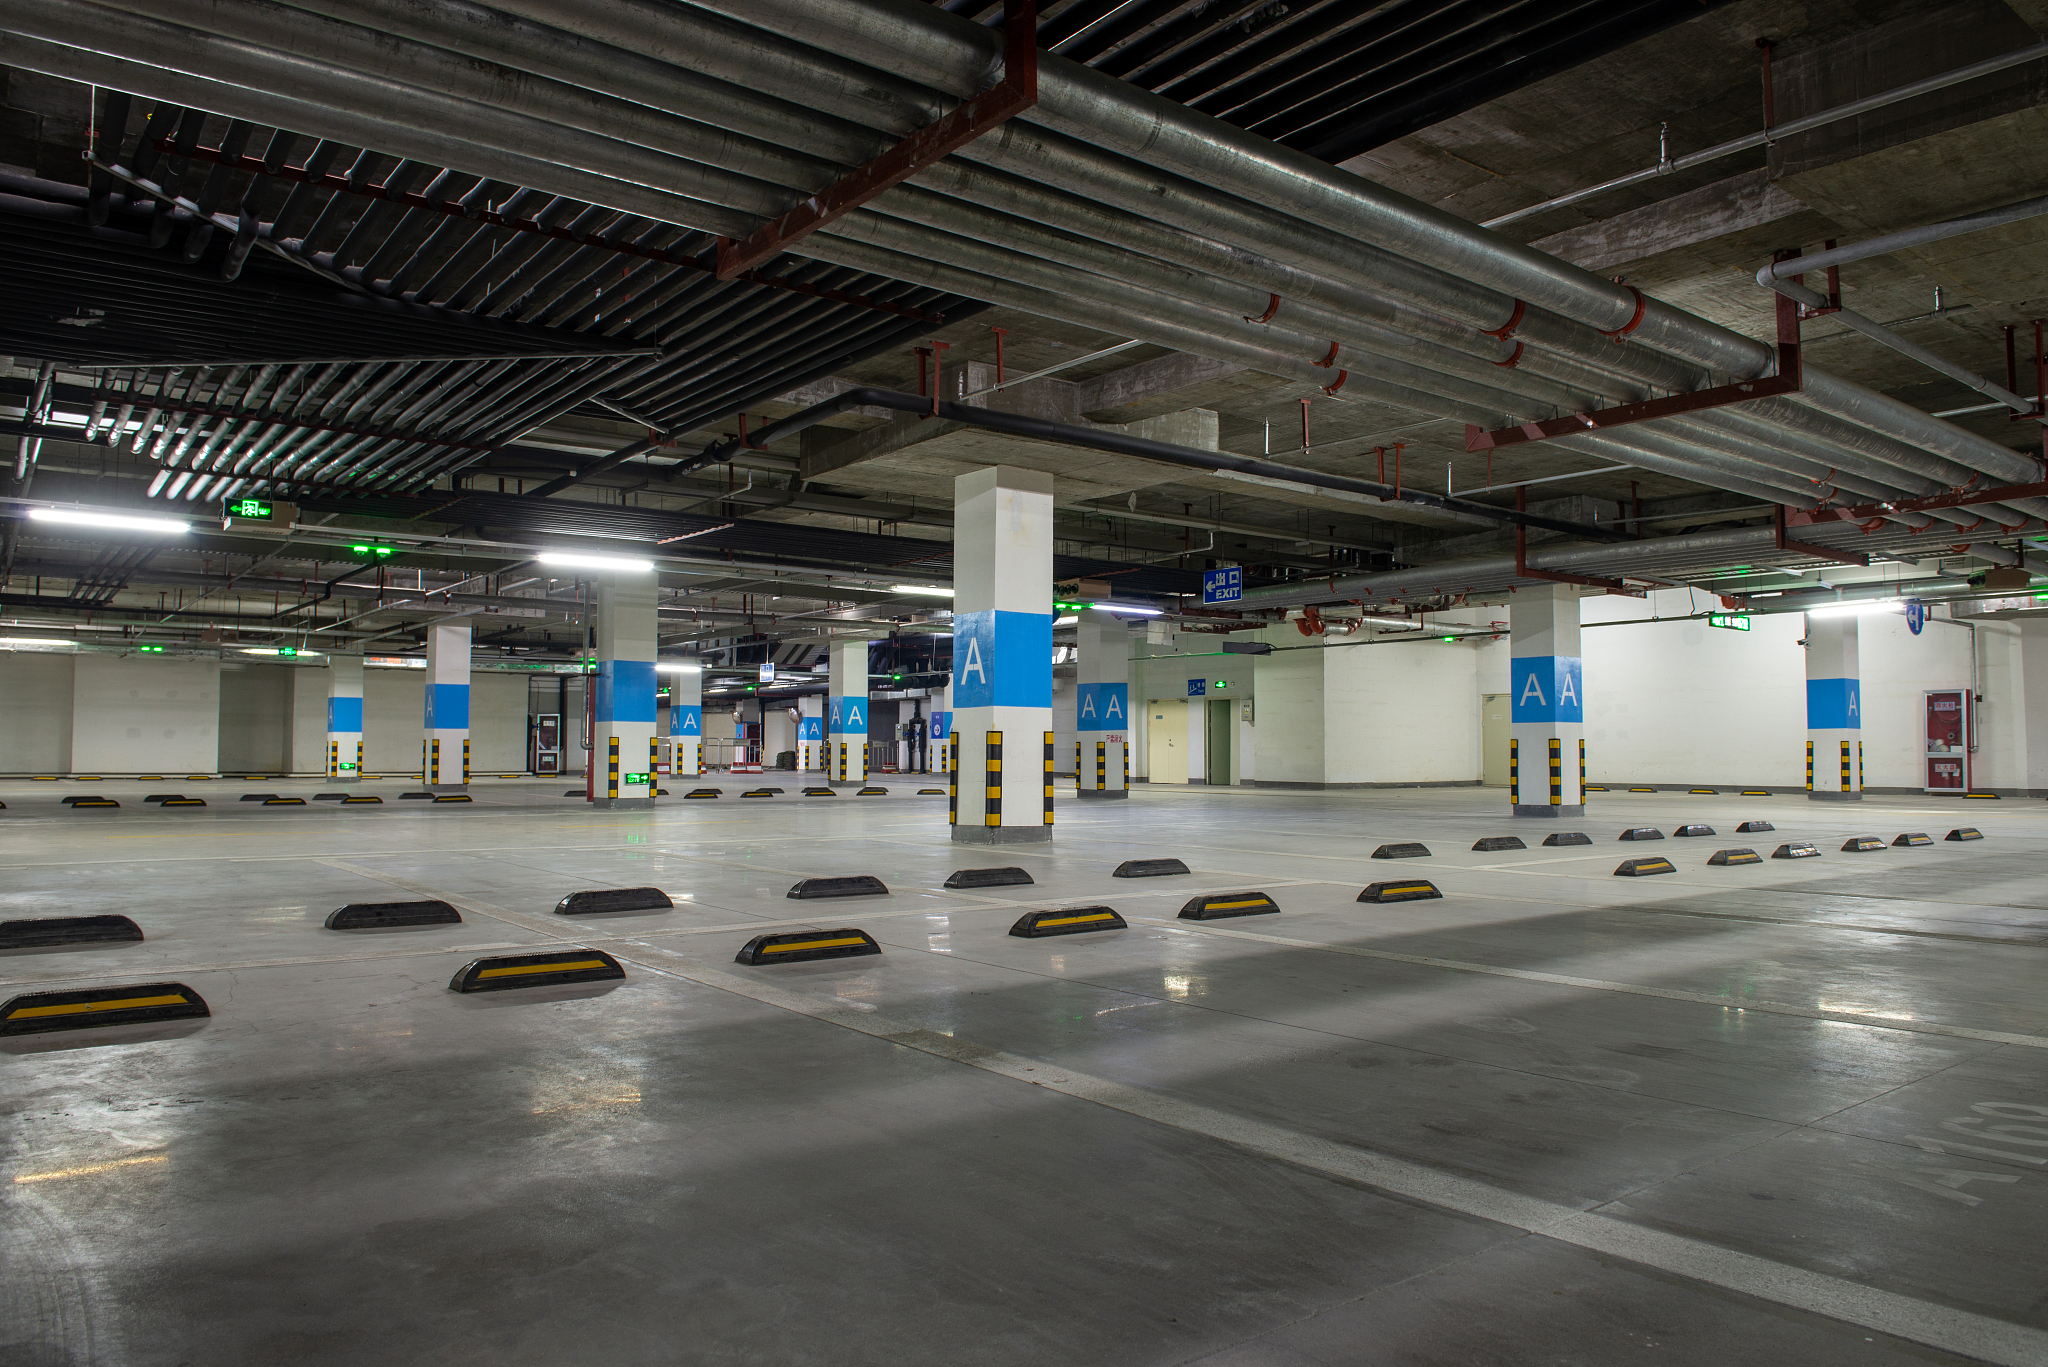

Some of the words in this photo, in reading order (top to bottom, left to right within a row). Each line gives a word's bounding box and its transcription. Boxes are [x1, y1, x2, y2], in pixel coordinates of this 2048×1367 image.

[1216, 571, 1239, 586] 出口
[1216, 587, 1239, 599] EXIT
[961, 637, 986, 685] A
[1520, 673, 1547, 706] A
[1560, 673, 1577, 706] A
[427, 695, 433, 717] A
[1082, 694, 1096, 718] A
[1106, 694, 1122, 718] A
[1849, 691, 1858, 716] A
[329, 705, 333, 724] A
[672, 713, 678, 728] A
[683, 713, 697, 728] A
[831, 706, 840, 725] A
[848, 706, 863, 725] A
[800, 723, 805, 735] A
[810, 723, 819, 735] A
